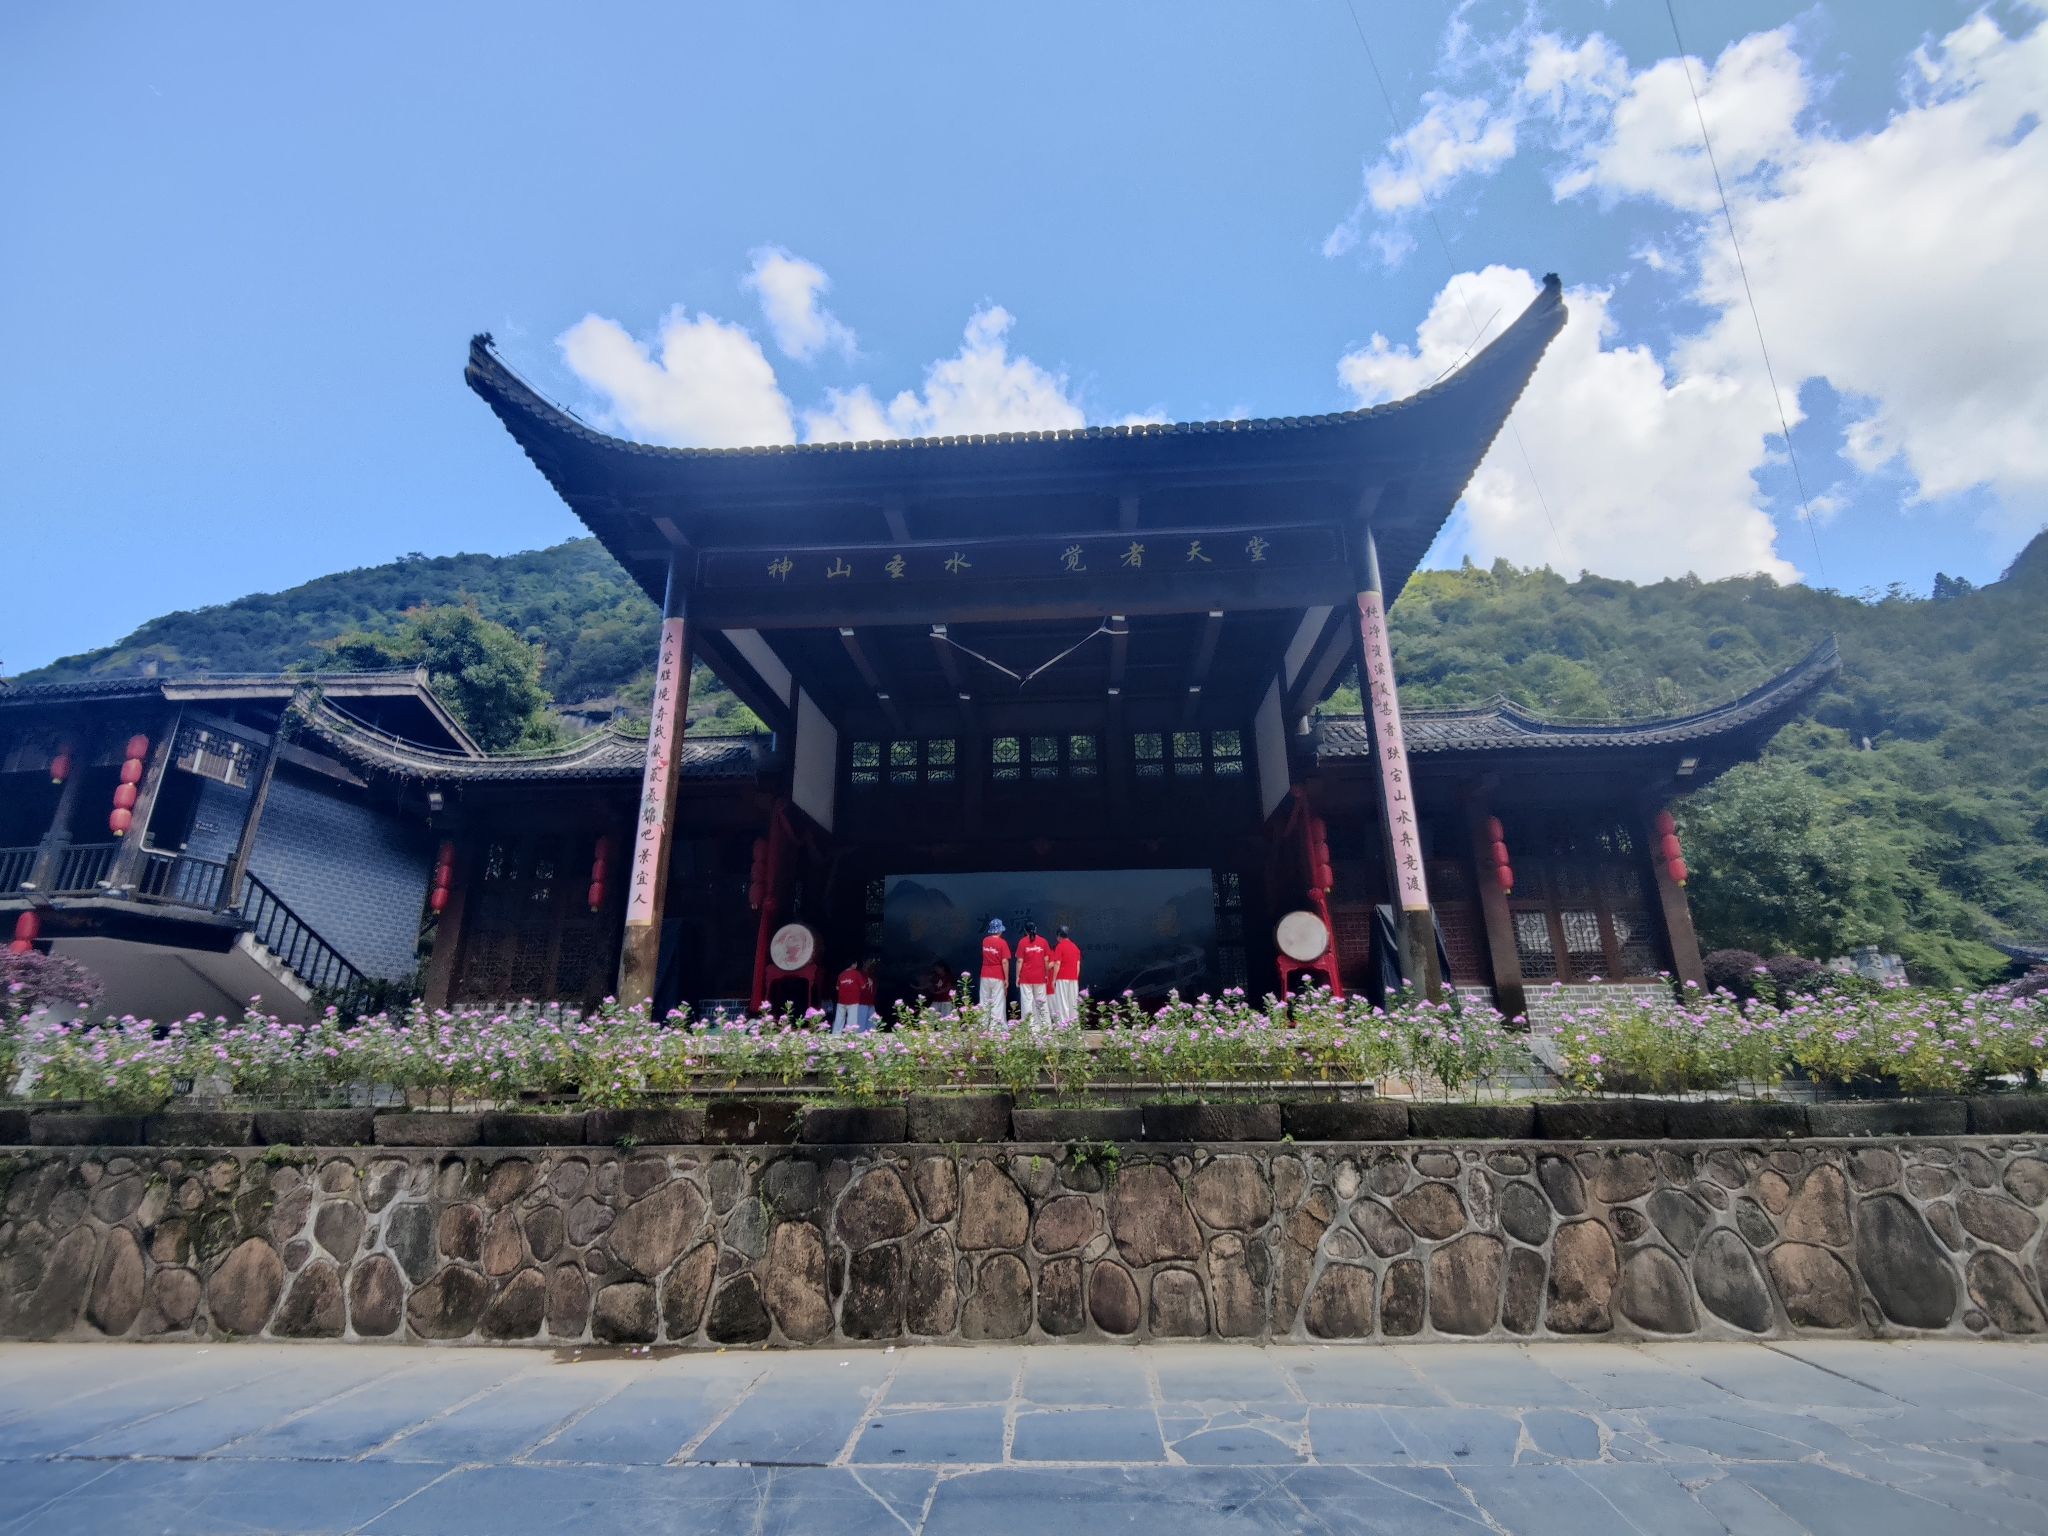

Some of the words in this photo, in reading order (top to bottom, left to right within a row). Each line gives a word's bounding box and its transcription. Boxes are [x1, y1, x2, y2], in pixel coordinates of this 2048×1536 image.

[766, 551, 972, 582] 神山圣水
[1059, 535, 1271, 573] 觉者天堂
